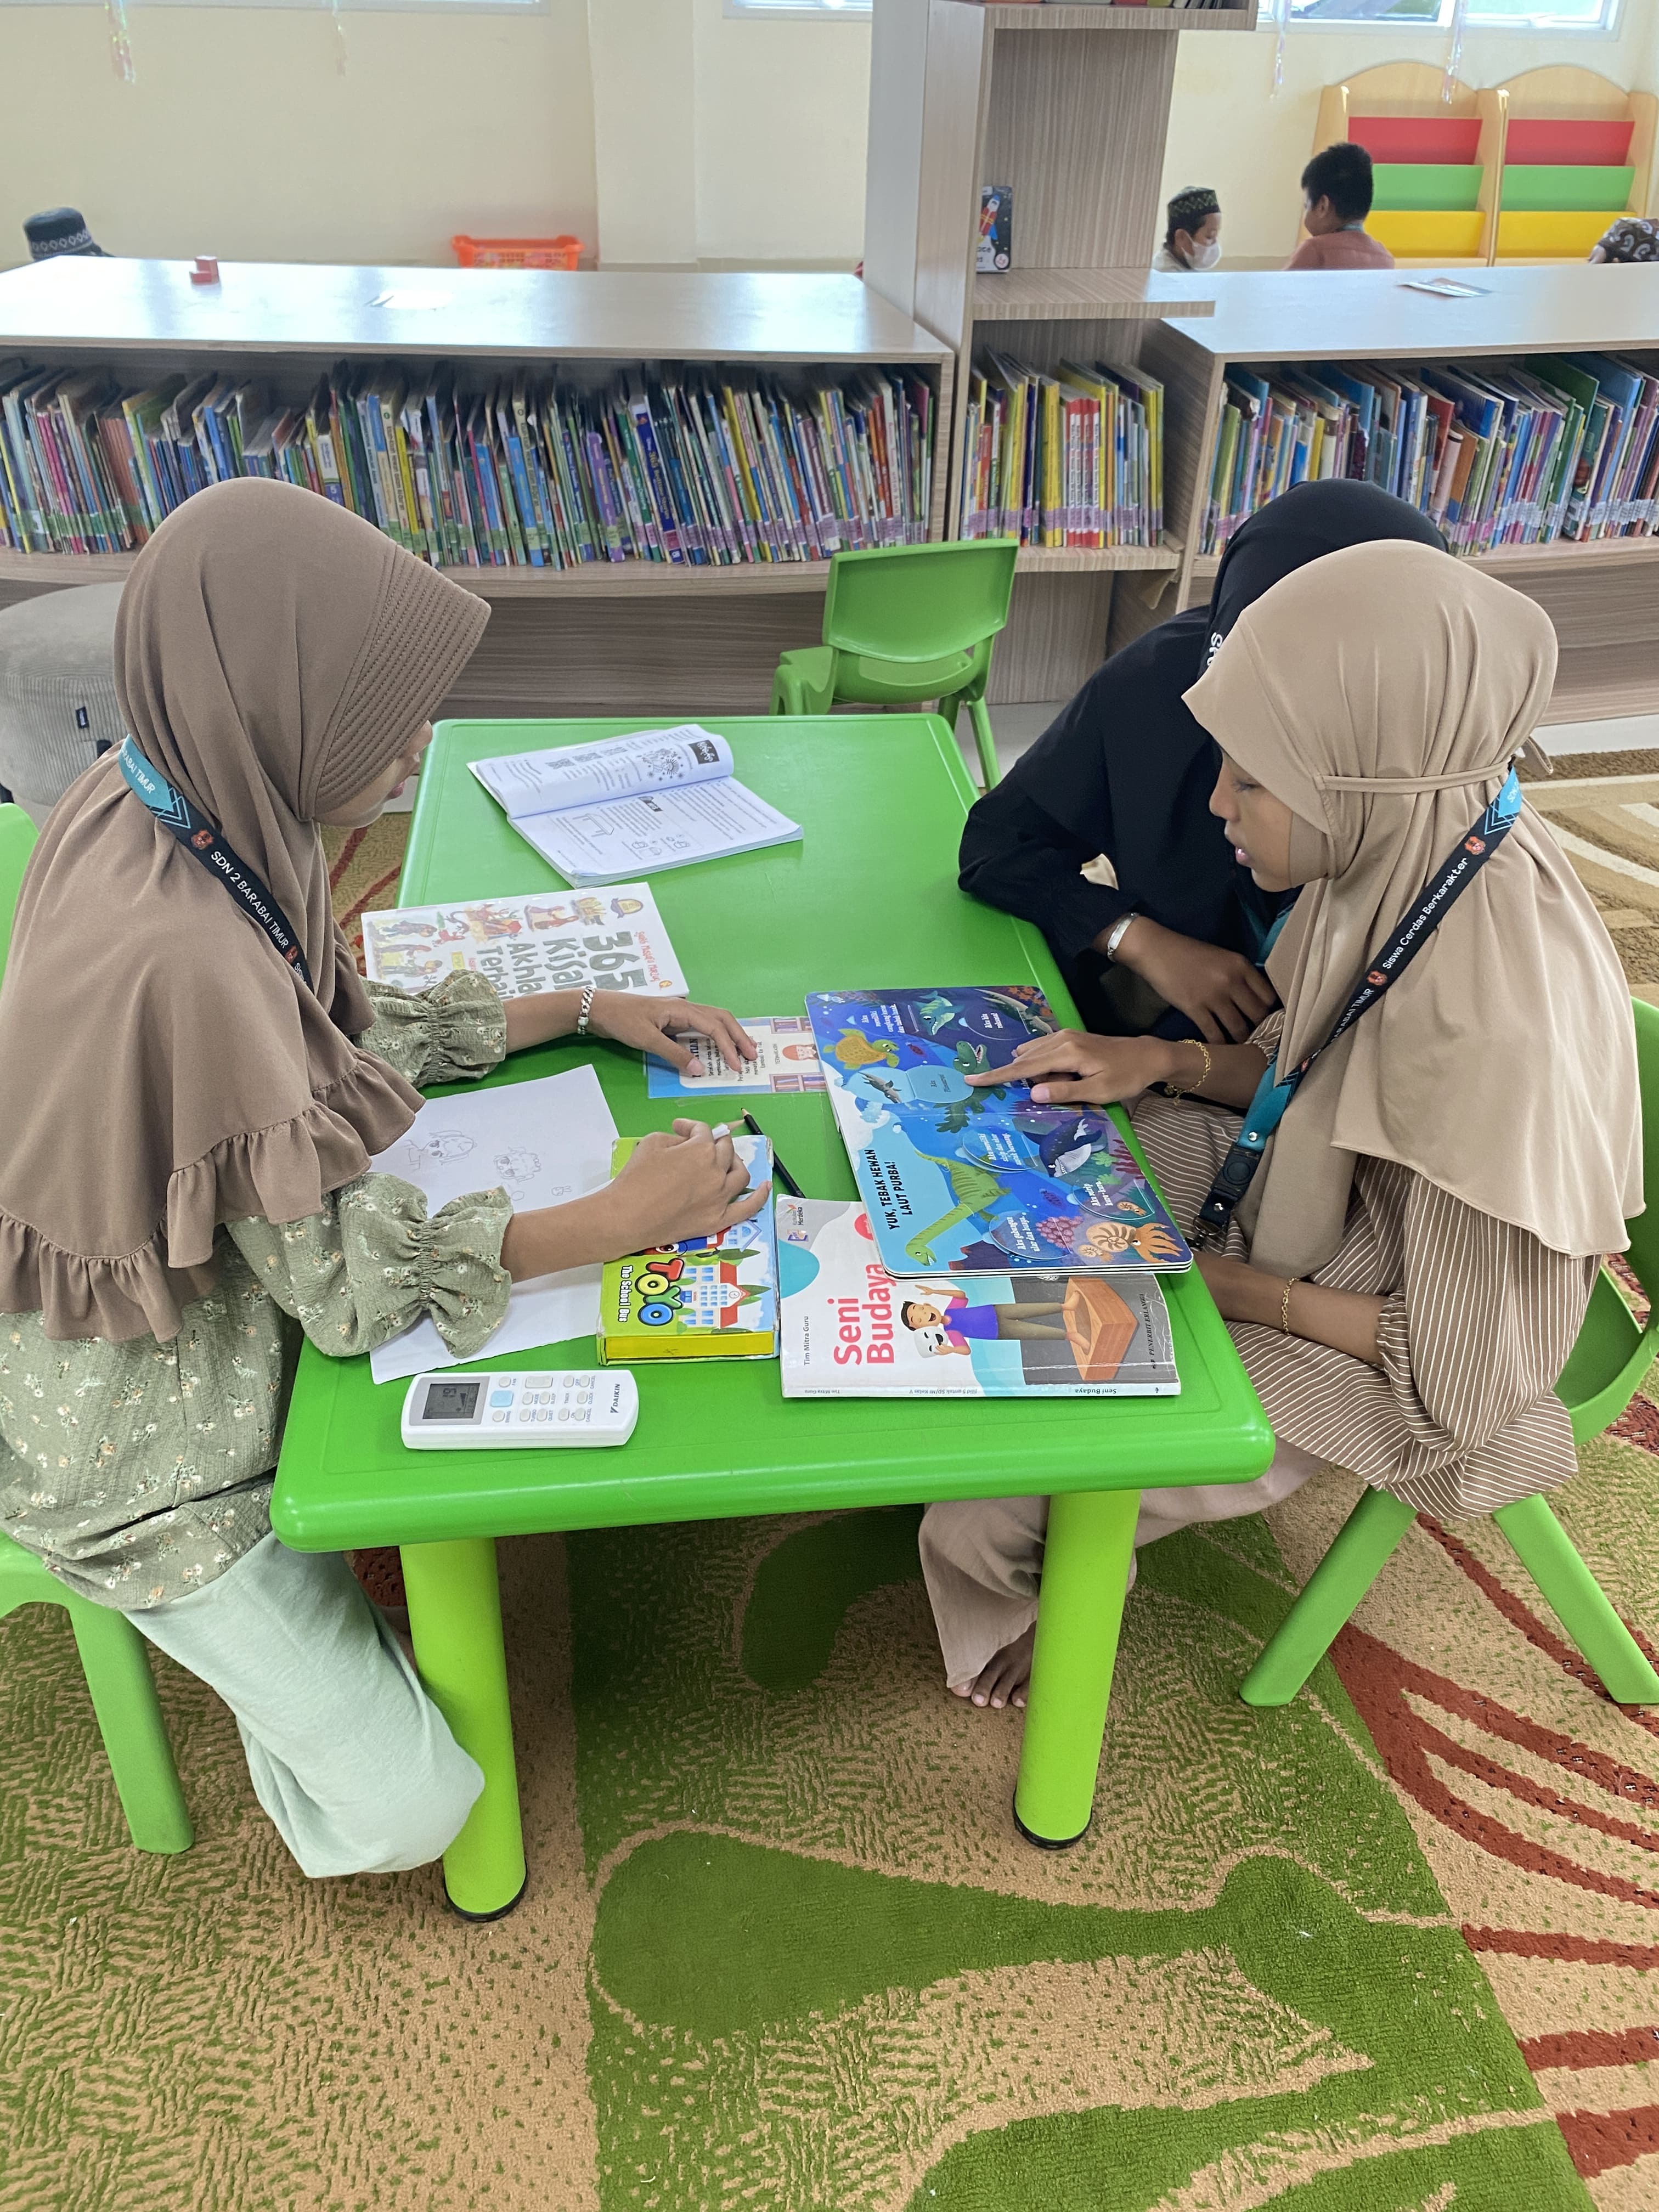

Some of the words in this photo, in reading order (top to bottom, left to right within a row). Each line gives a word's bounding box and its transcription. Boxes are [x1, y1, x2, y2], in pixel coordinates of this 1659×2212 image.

[136, 769, 155, 794] TIMUR
[211, 851, 234, 874] SDN
[230, 873, 240, 883] 2
[237, 880, 273, 924] BARABAI
[269, 921, 289, 949] TIMUR
[1383, 946, 1403, 969] Siswa
[1400, 913, 1426, 945] Cerdas
[1422, 857, 1469, 915] Berkarakter
[477, 945, 515, 1000] Terbai
[507, 943, 546, 996] Akhla
[583, 931, 648, 991] 365
[1351, 988, 1374, 1007] TIMUR
[864, 1149, 883, 1177] HEWAN
[884, 1161, 905, 1191] PURBA!
[874, 1180, 893, 1206] TEBAK
[1083, 1183, 1096, 1196] mirip
[1091, 1197, 1101, 1206] Aku
[895, 1193, 913, 1215] LAUT
[884, 1209, 900, 1229] YUK,
[1016, 1239, 1026, 1250] Aku
[1026, 1232, 1035, 1240] dan
[621, 1265, 633, 1278] The
[619, 1280, 632, 1306] School
[635, 1258, 684, 1326] TOYO
[618, 1308, 630, 1322] Bus
[862, 1264, 897, 1364] Budaya
[827, 1298, 862, 1365] Seni
[1146, 1323, 1154, 1356] PENERBIT
[612, 1384, 620, 1407] DAIKIN
